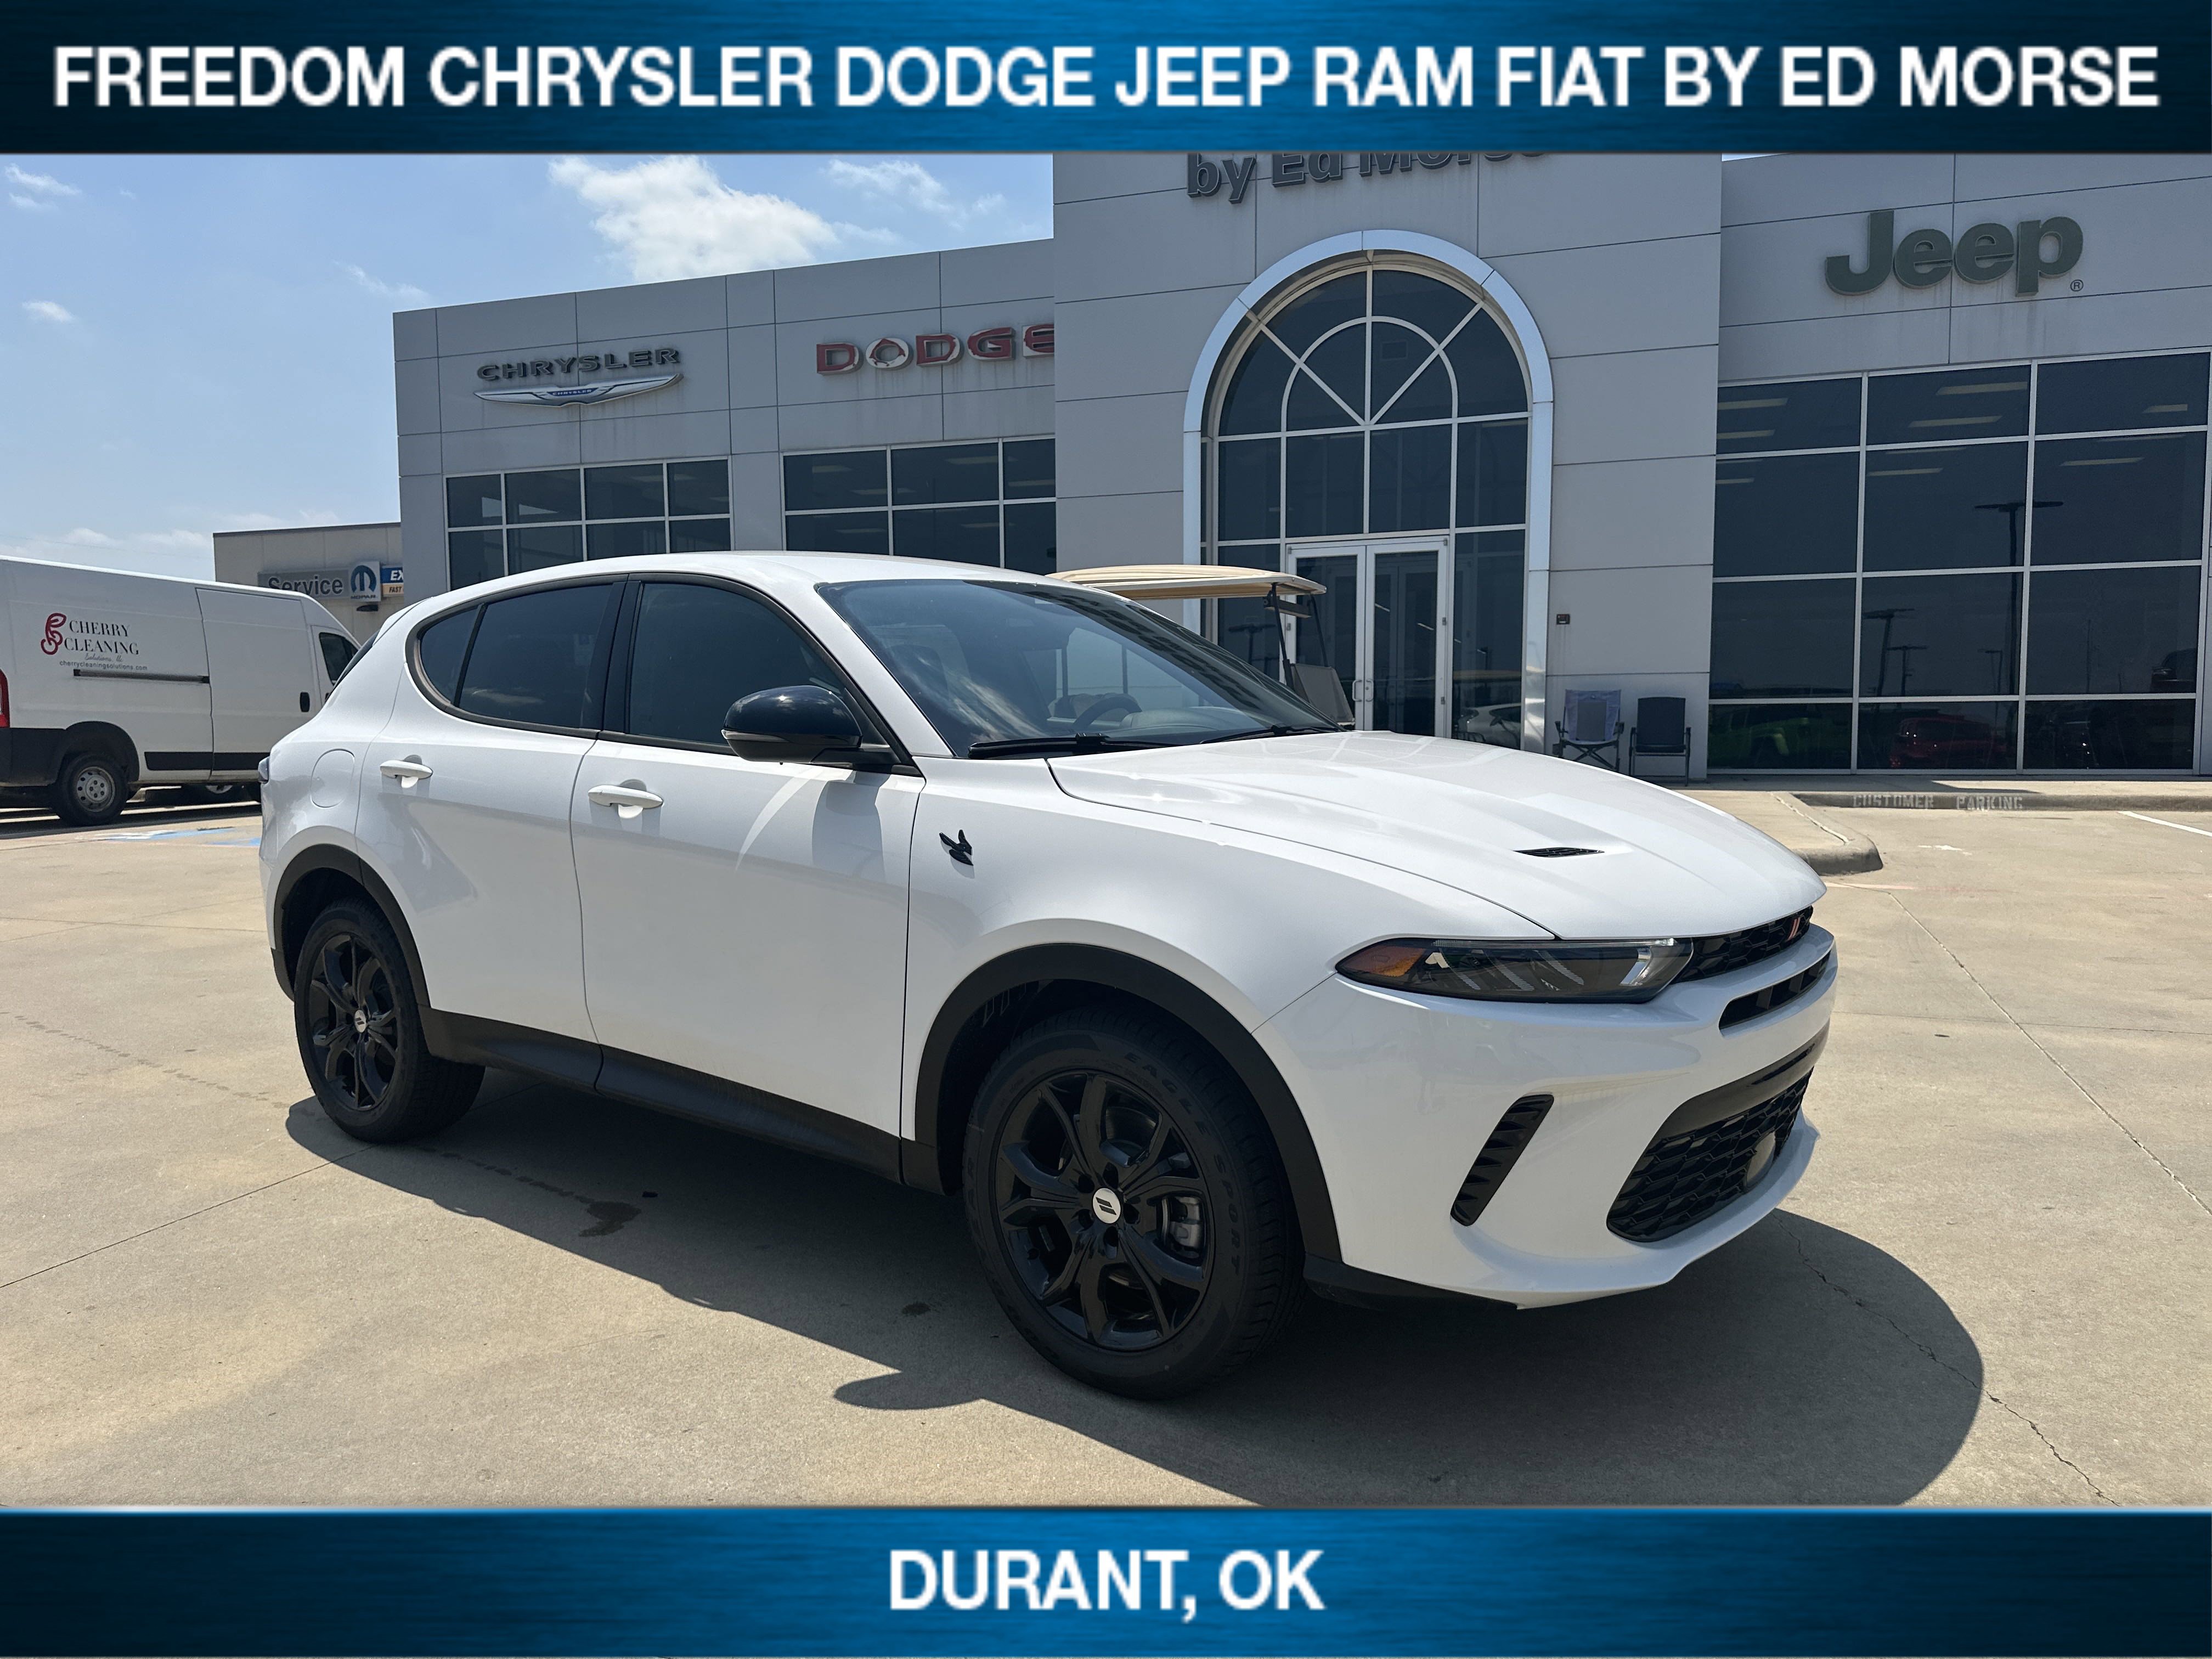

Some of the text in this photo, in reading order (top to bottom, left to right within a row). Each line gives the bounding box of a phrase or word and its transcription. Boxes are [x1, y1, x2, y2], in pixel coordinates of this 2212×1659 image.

[1187, 153, 1256, 204] by
[1825, 210, 2083, 297] Jeep
[815, 323, 1054, 375] DODGE
[477, 348, 681, 381] CHRYSLER
[268, 575, 343, 595] Service
[69, 620, 131, 637] CHERRY
[64, 637, 139, 655] CLEANING
[59, 660, 148, 670] cherrycleaningsolutions.com
[1853, 794, 2023, 810] CUSTOMER PARKING
